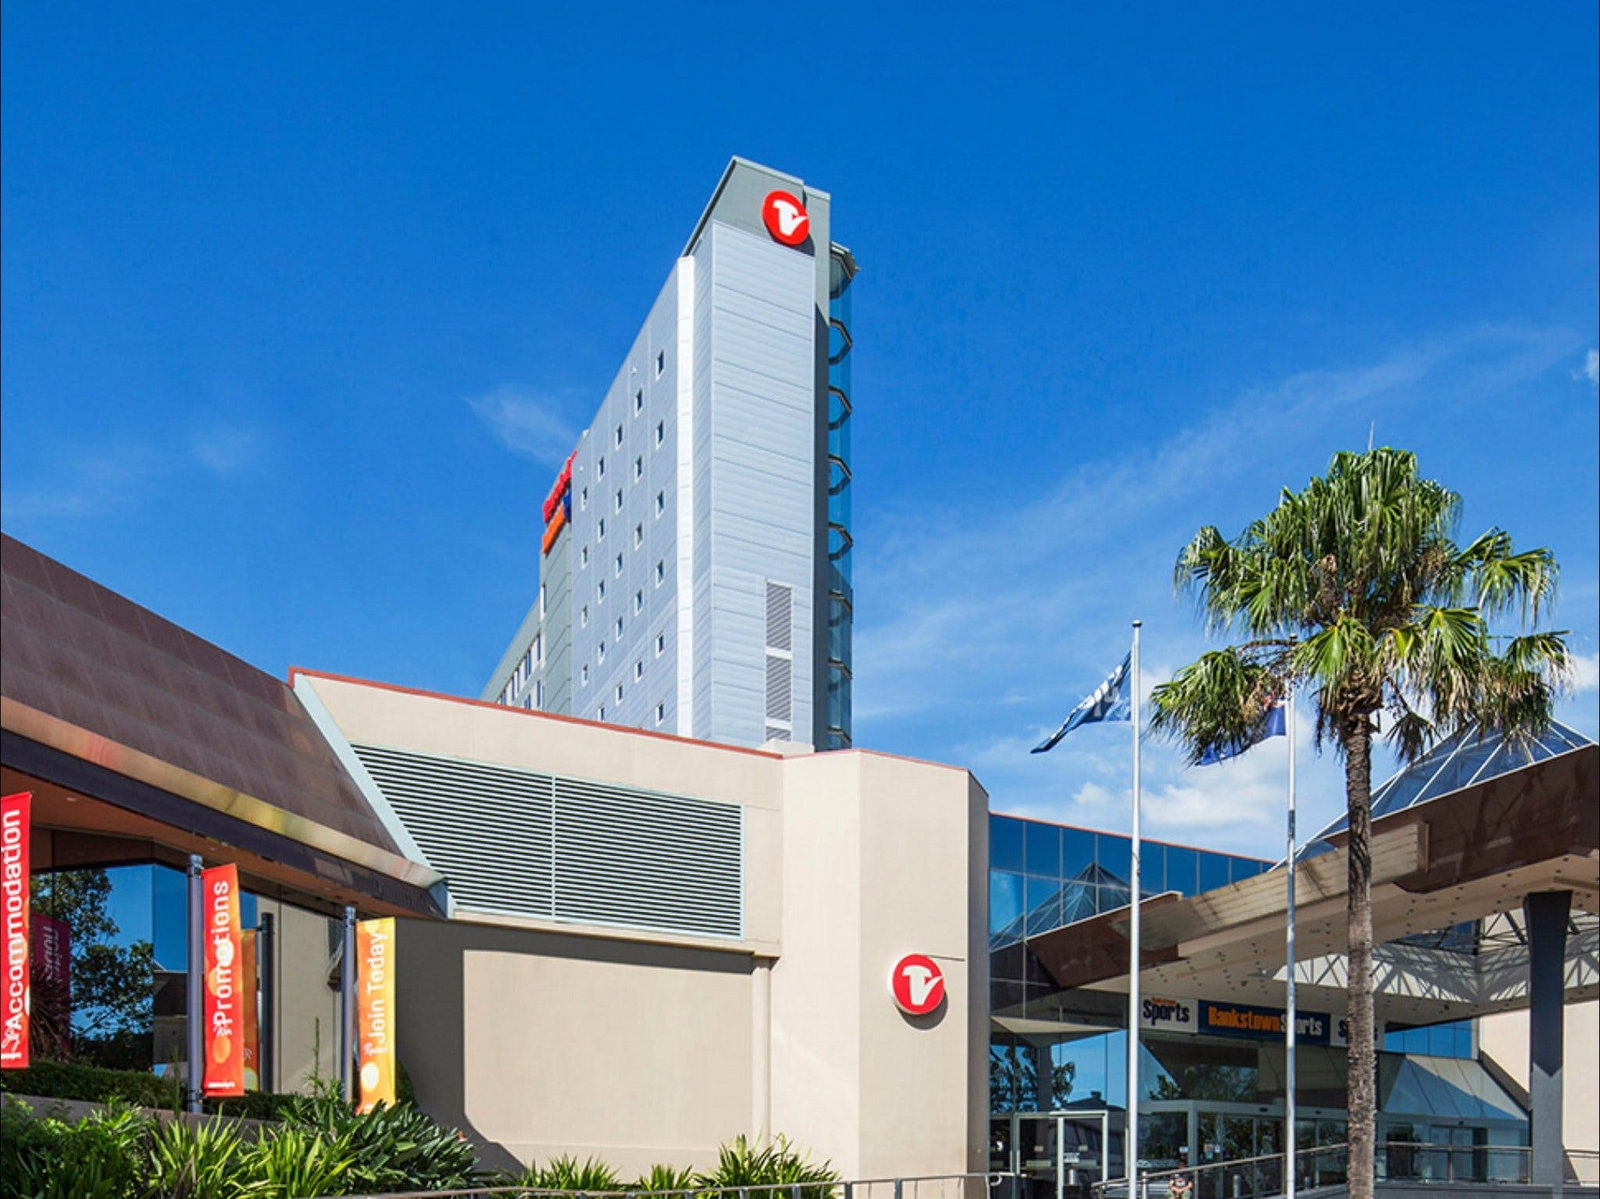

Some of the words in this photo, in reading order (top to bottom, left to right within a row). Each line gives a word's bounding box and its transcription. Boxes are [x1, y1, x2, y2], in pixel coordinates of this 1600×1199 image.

[1, 808, 24, 1030] Accommodation
[211, 880, 233, 1026] Promotions
[367, 933, 388, 995] Today
[368, 999, 386, 1044] Join
[1143, 999, 1189, 1026] Sports
[1208, 1006, 1323, 1036] BankstownSorts
